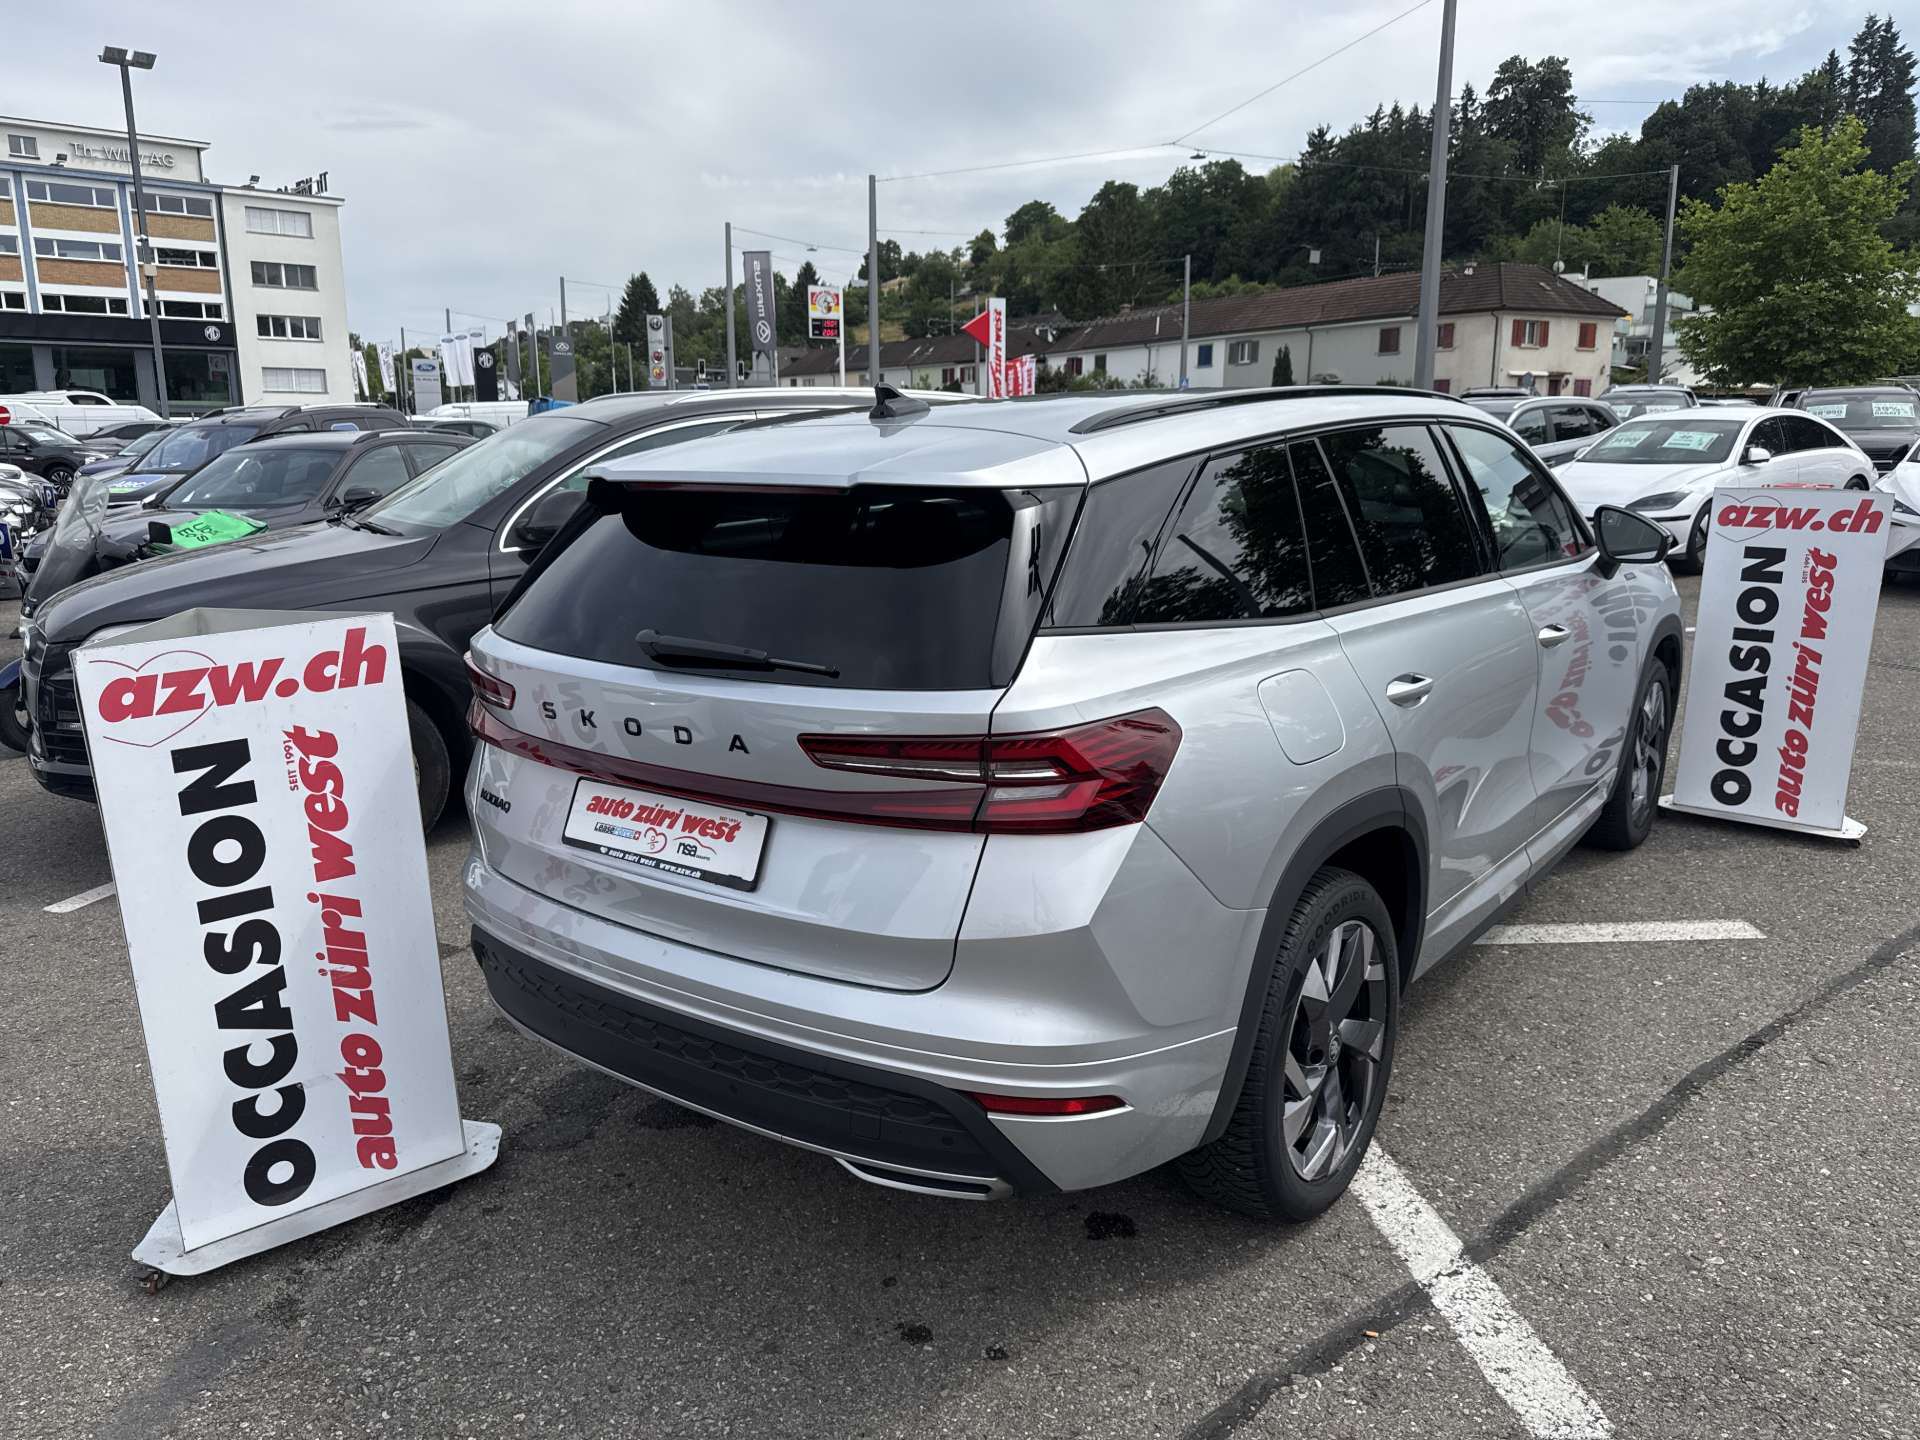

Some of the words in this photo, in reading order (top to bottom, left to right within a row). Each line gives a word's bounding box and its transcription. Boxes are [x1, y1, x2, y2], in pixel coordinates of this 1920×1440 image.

[150, 151, 176, 167] AG
[478, 352, 494, 369] MG
[1717, 499, 1883, 534] azw.ch
[1800, 546, 1838, 640] west
[98, 627, 387, 722] azw.ch
[1710, 545, 1787, 806] OCCASION
[1785, 641, 1823, 731] züri
[283, 739, 296, 766] 1991
[542, 701, 750, 754] SKODA
[287, 769, 299, 792] SEIT
[1775, 729, 1809, 818] auto
[282, 724, 357, 882] west
[480, 787, 512, 814] KODIAQ
[586, 795, 634, 819] auto
[631, 803, 684, 830] züri
[680, 814, 743, 843] west
[608, 848, 624, 859] auto
[639, 857, 657, 867] west
[676, 841, 698, 858] nsa
[171, 737, 317, 1207] OCCASION
[307, 891, 378, 1026] züri
[335, 1033, 399, 1170] auto
